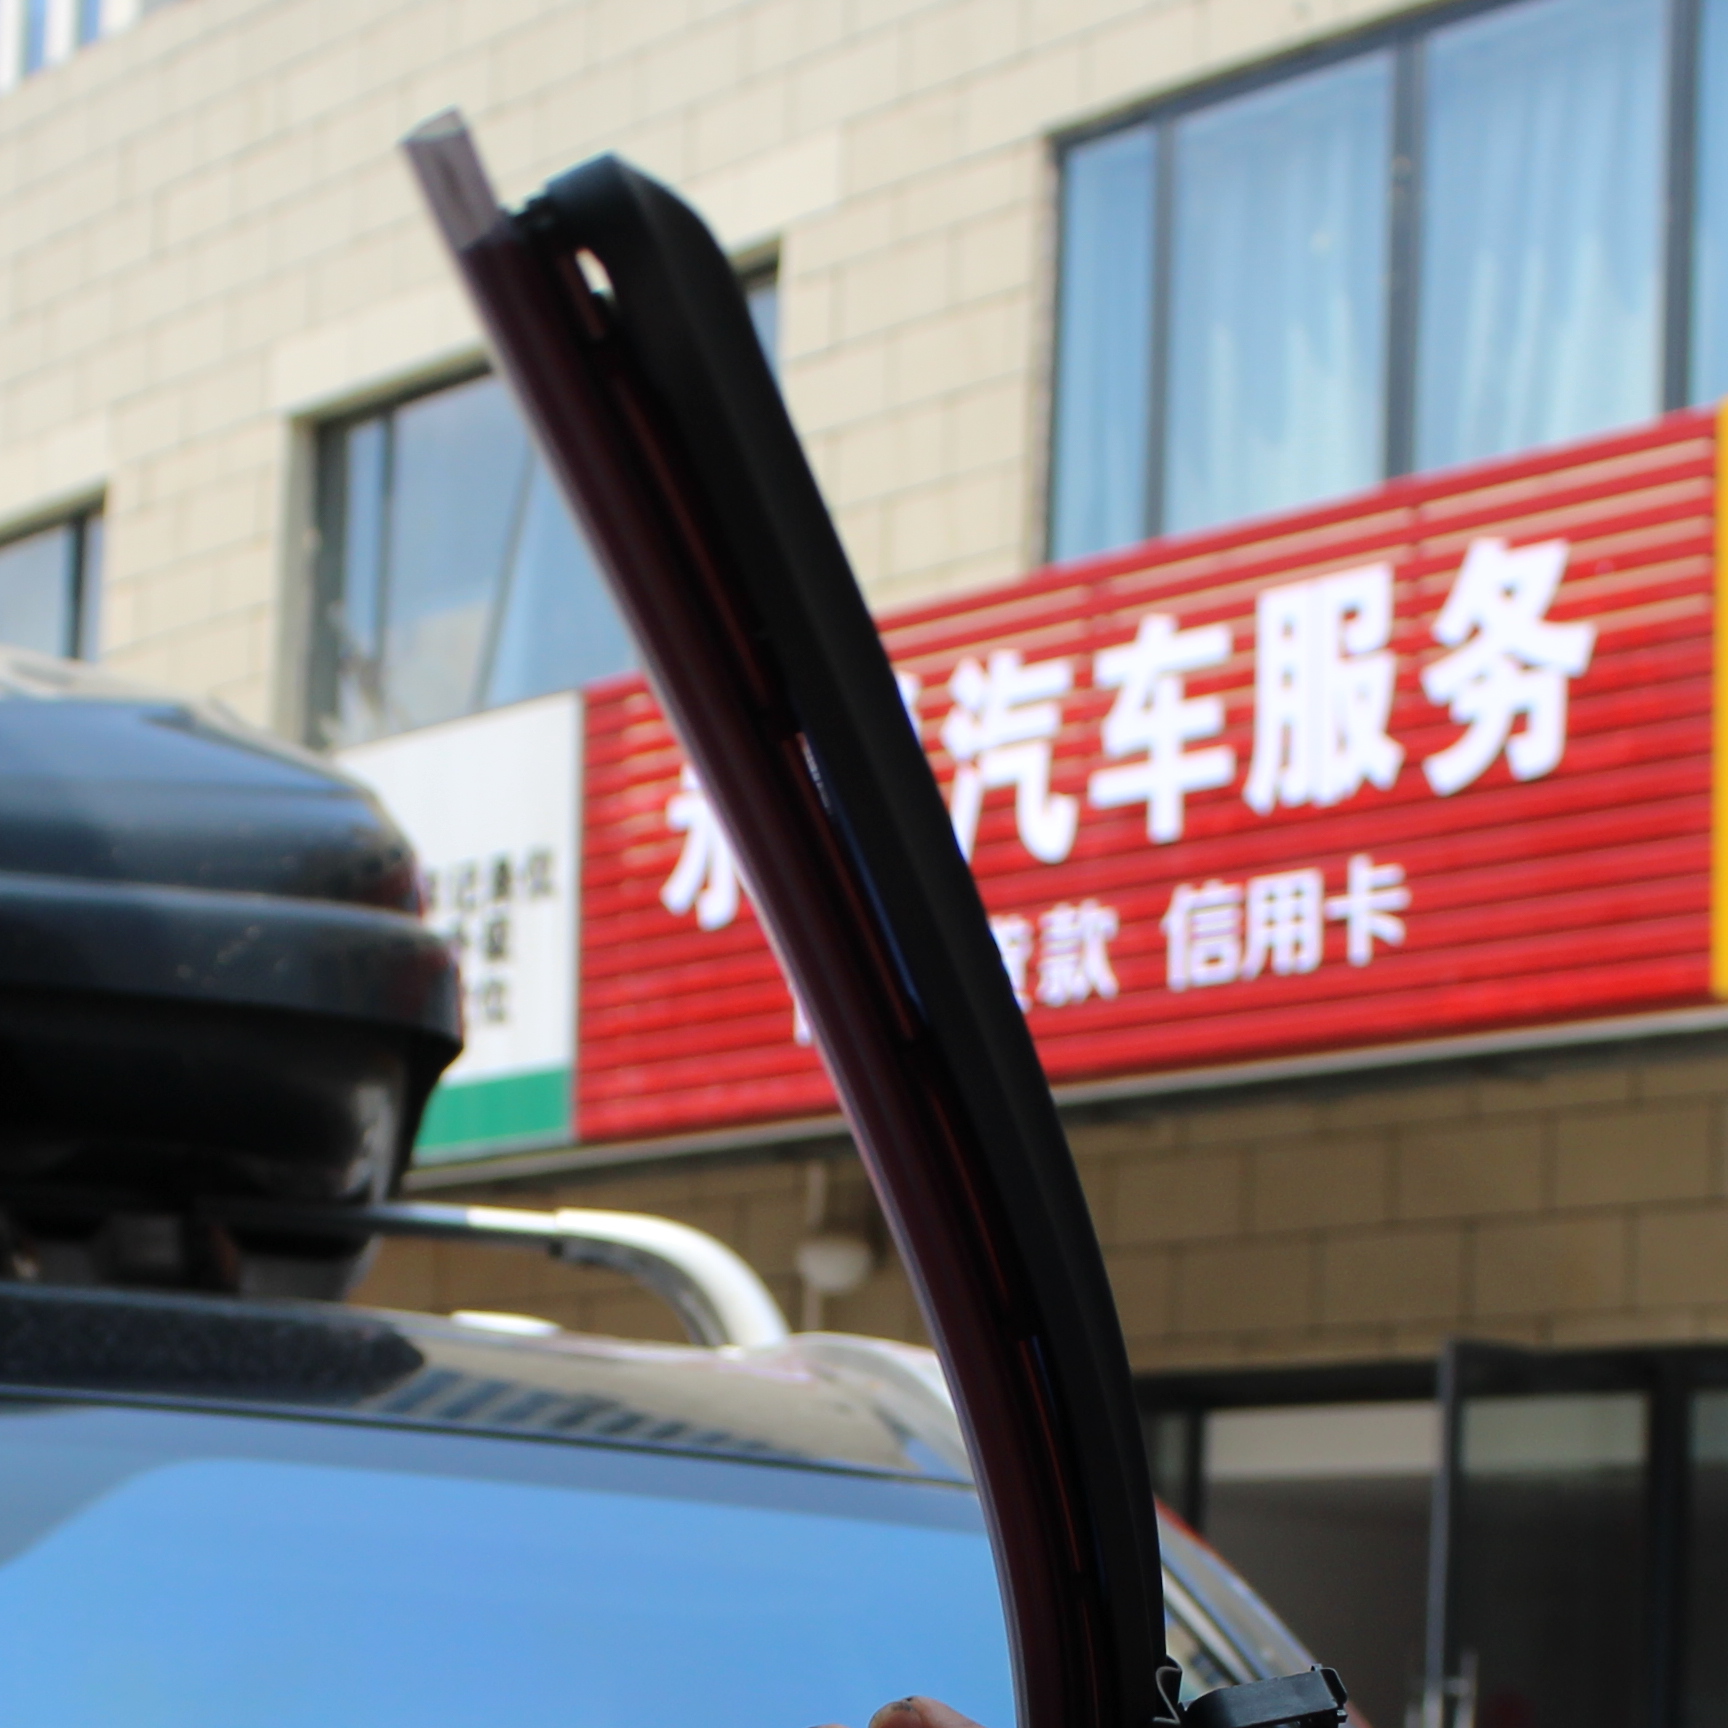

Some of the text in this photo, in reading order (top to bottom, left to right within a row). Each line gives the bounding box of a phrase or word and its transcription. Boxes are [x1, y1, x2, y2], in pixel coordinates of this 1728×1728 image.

[660, 536, 1600, 932] 汽车服务
[1162, 853, 1412, 992] 信用卡
